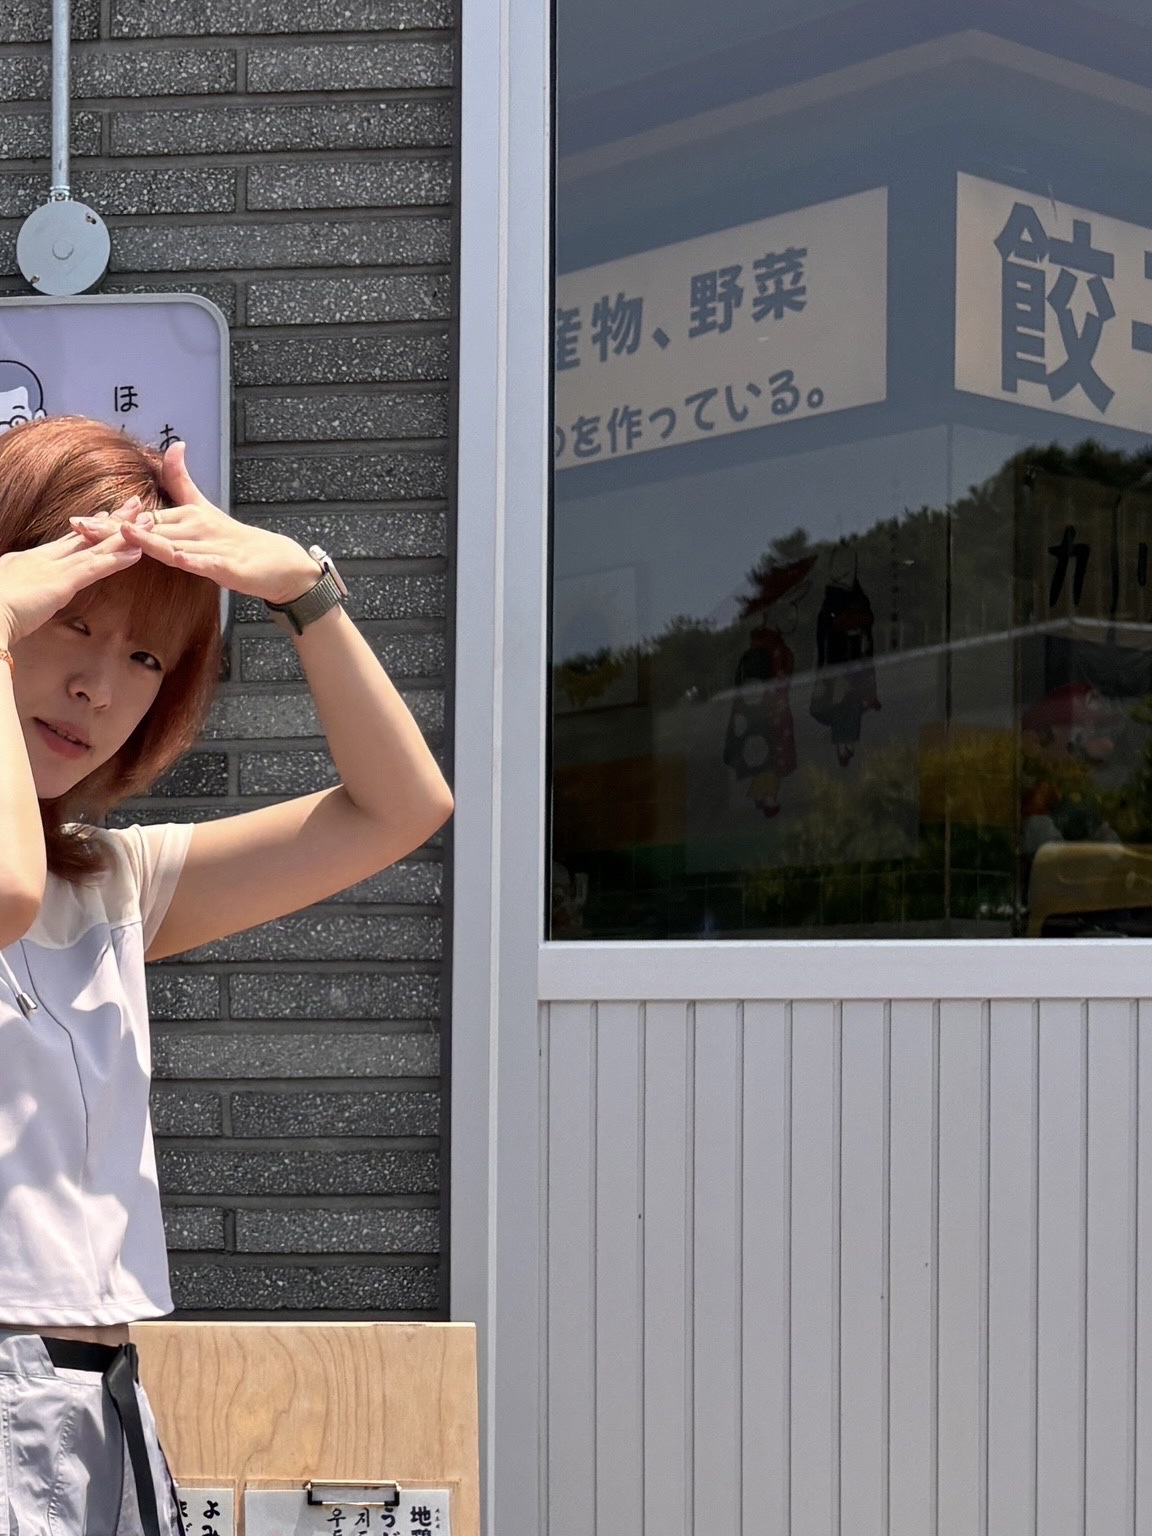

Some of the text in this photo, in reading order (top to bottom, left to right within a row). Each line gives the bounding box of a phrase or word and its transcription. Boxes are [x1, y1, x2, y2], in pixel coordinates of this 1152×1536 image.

[994, 202, 1152, 413] 餃
[555, 369, 825, 458] を作っている。
